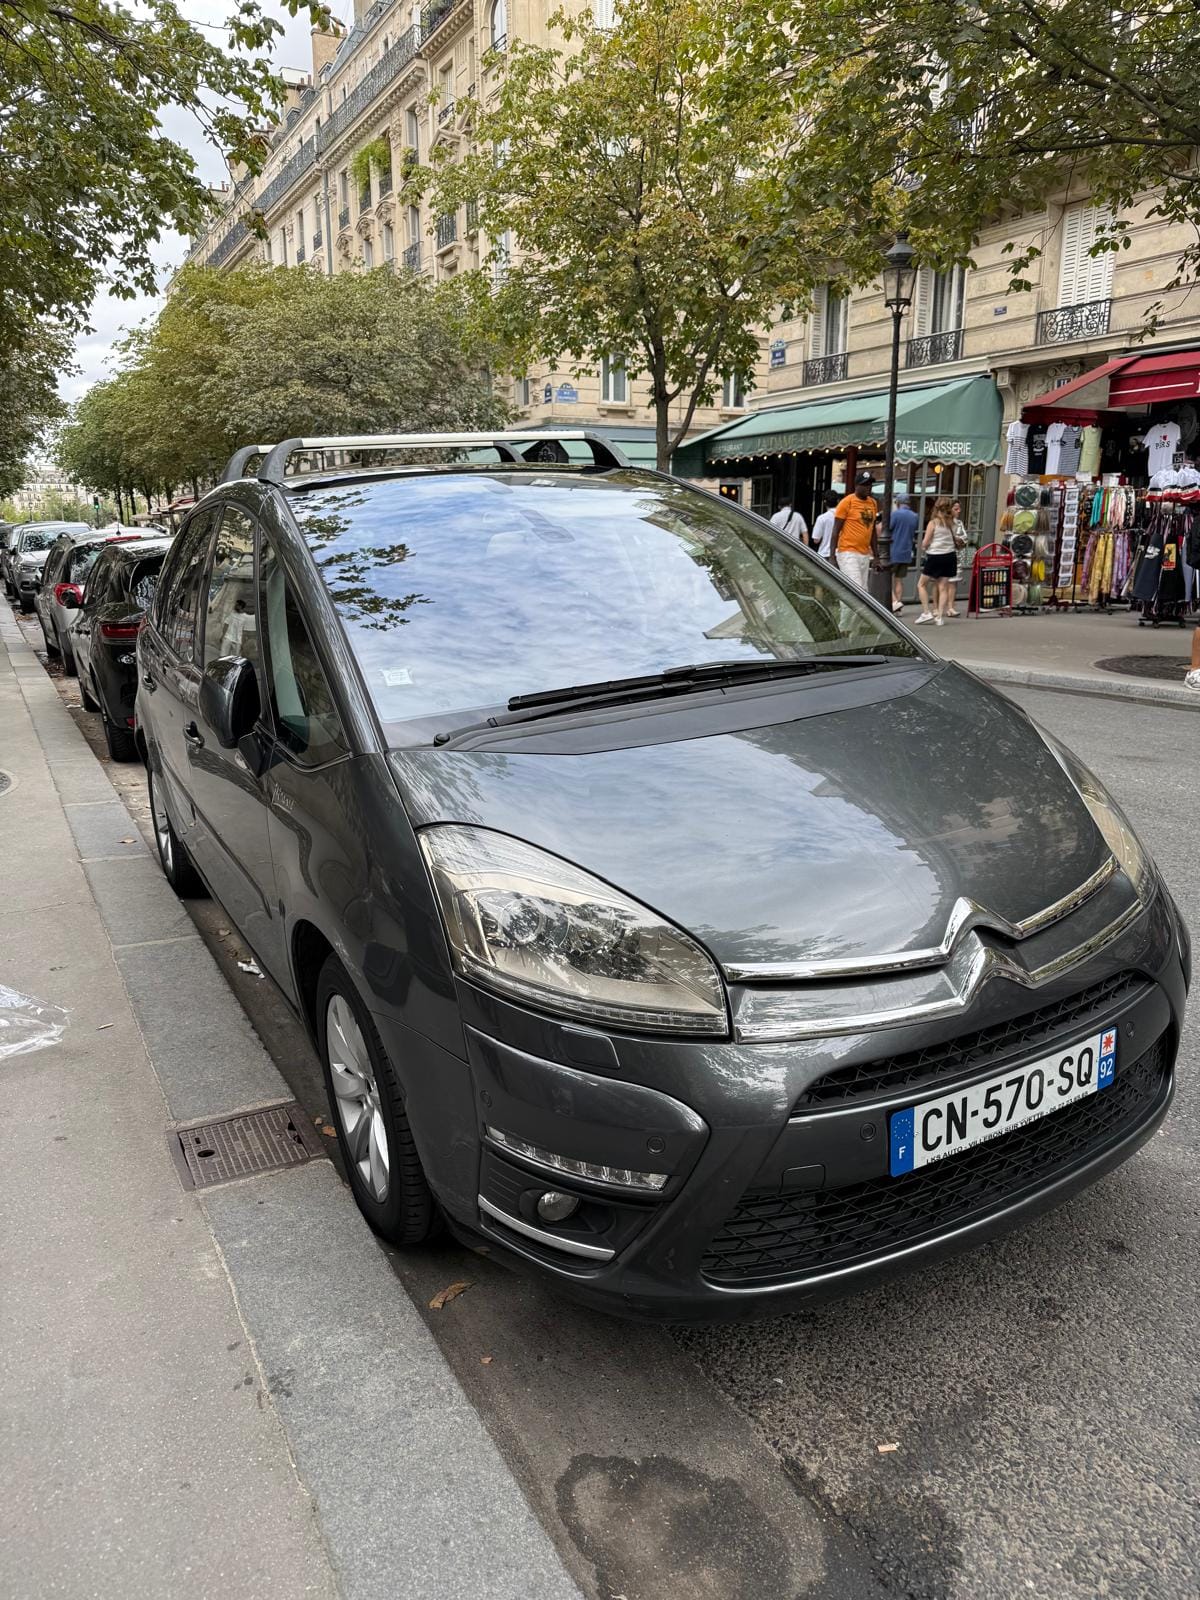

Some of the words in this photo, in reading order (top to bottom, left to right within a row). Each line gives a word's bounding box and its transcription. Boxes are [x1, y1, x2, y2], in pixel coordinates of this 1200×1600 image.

[1100, 1058, 1113, 1079] 92
[922, 1047, 1094, 1152] CN-570-SQ
[898, 1146, 906, 1159] F
